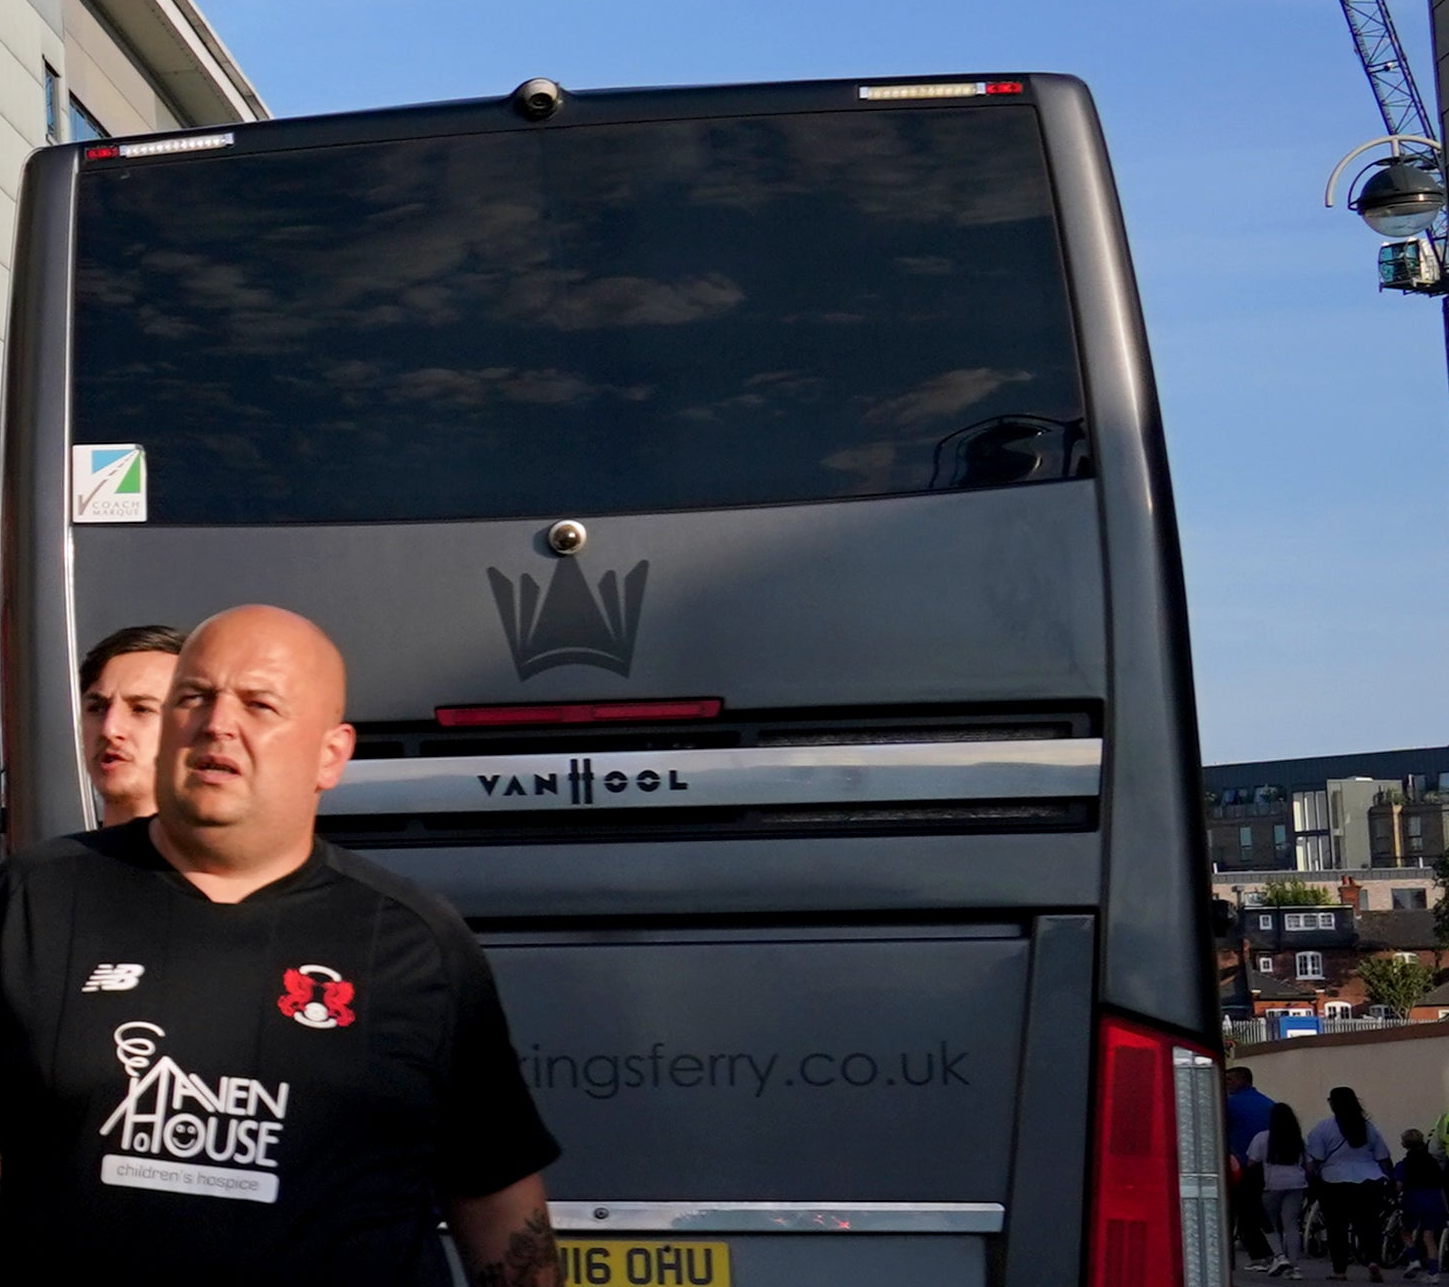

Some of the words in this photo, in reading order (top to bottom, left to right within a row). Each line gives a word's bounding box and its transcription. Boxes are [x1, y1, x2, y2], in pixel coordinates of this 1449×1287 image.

[92, 501, 140, 509] COACH
[116, 1162, 193, 1185] children's
[197, 1171, 259, 1193] hospice
